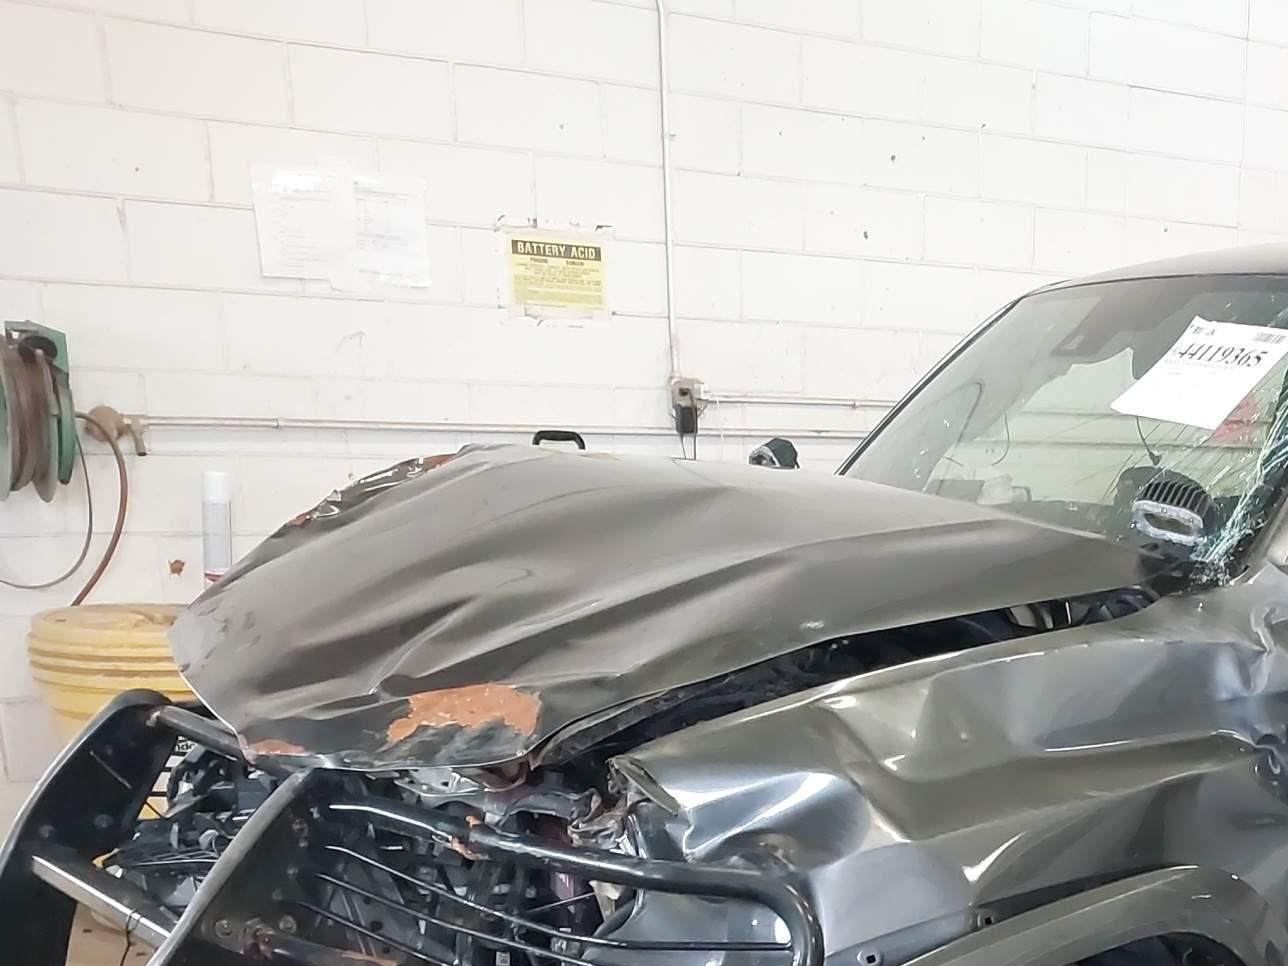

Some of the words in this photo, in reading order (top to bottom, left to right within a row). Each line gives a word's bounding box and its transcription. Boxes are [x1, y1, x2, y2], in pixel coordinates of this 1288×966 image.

[517, 241, 566, 256] BATTERY
[571, 246, 596, 259] ACID
[1178, 342, 1268, 368] 44119365
